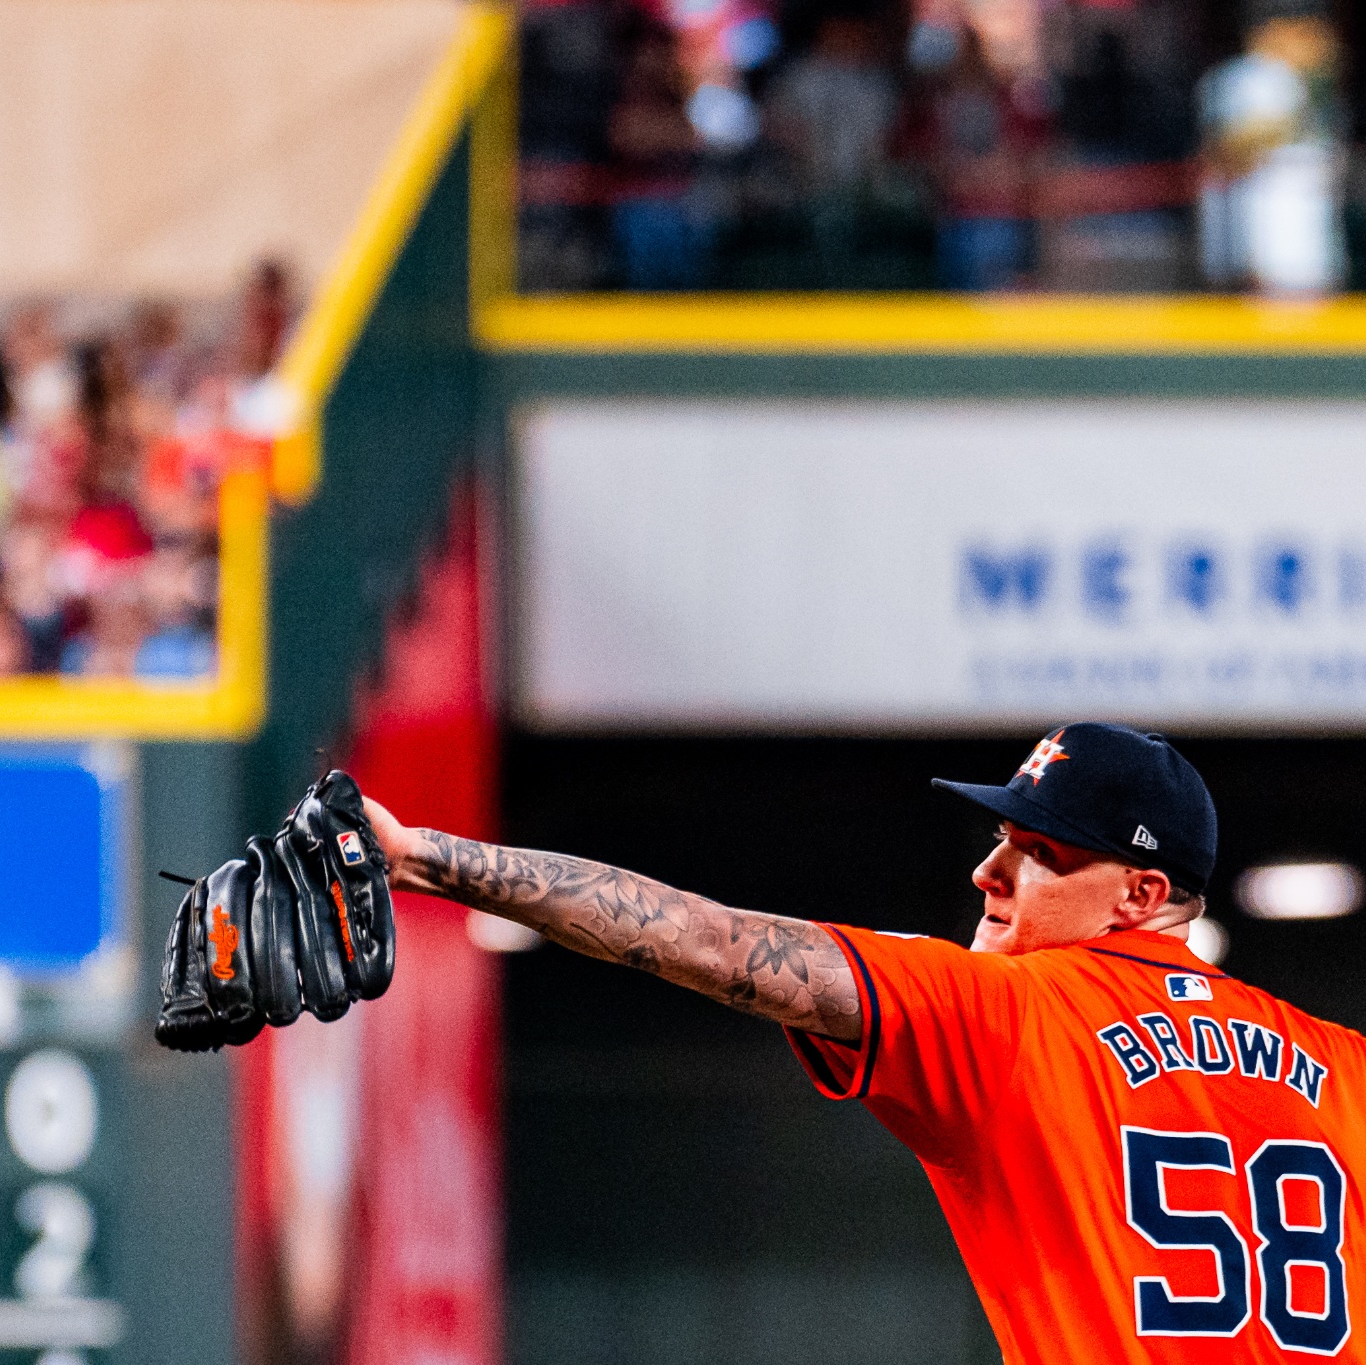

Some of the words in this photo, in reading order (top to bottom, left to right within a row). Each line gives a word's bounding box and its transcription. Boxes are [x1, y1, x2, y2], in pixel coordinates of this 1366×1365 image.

[1019, 738, 1066, 780] H
[5, 1050, 98, 1174] 0
[1096, 1012, 1328, 1108] BROWN
[15, 1183, 95, 1306] 2
[1120, 1124, 1352, 1356] 58
